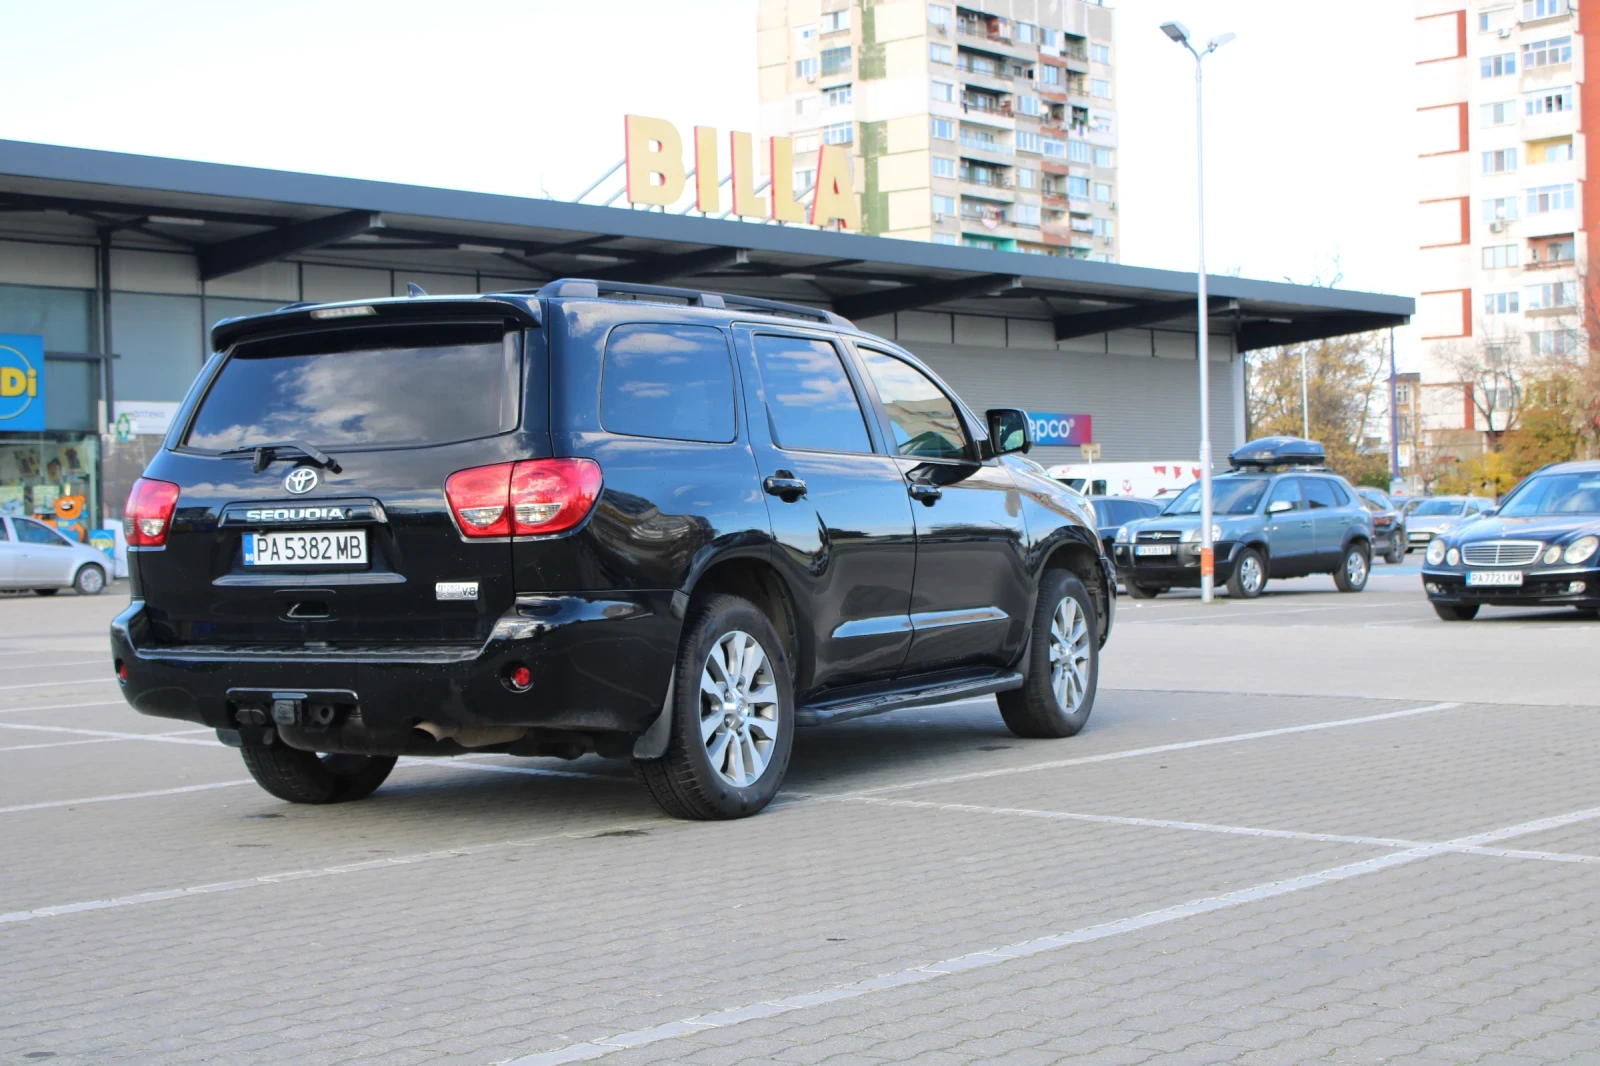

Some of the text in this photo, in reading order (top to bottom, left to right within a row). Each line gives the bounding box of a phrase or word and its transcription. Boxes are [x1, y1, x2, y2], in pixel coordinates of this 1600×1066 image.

[624, 113, 862, 229] BILLA
[0, 366, 37, 397] Di
[1029, 419, 1070, 442] epco
[246, 508, 346, 522] SEQUOIA
[461, 587, 477, 597] V8
